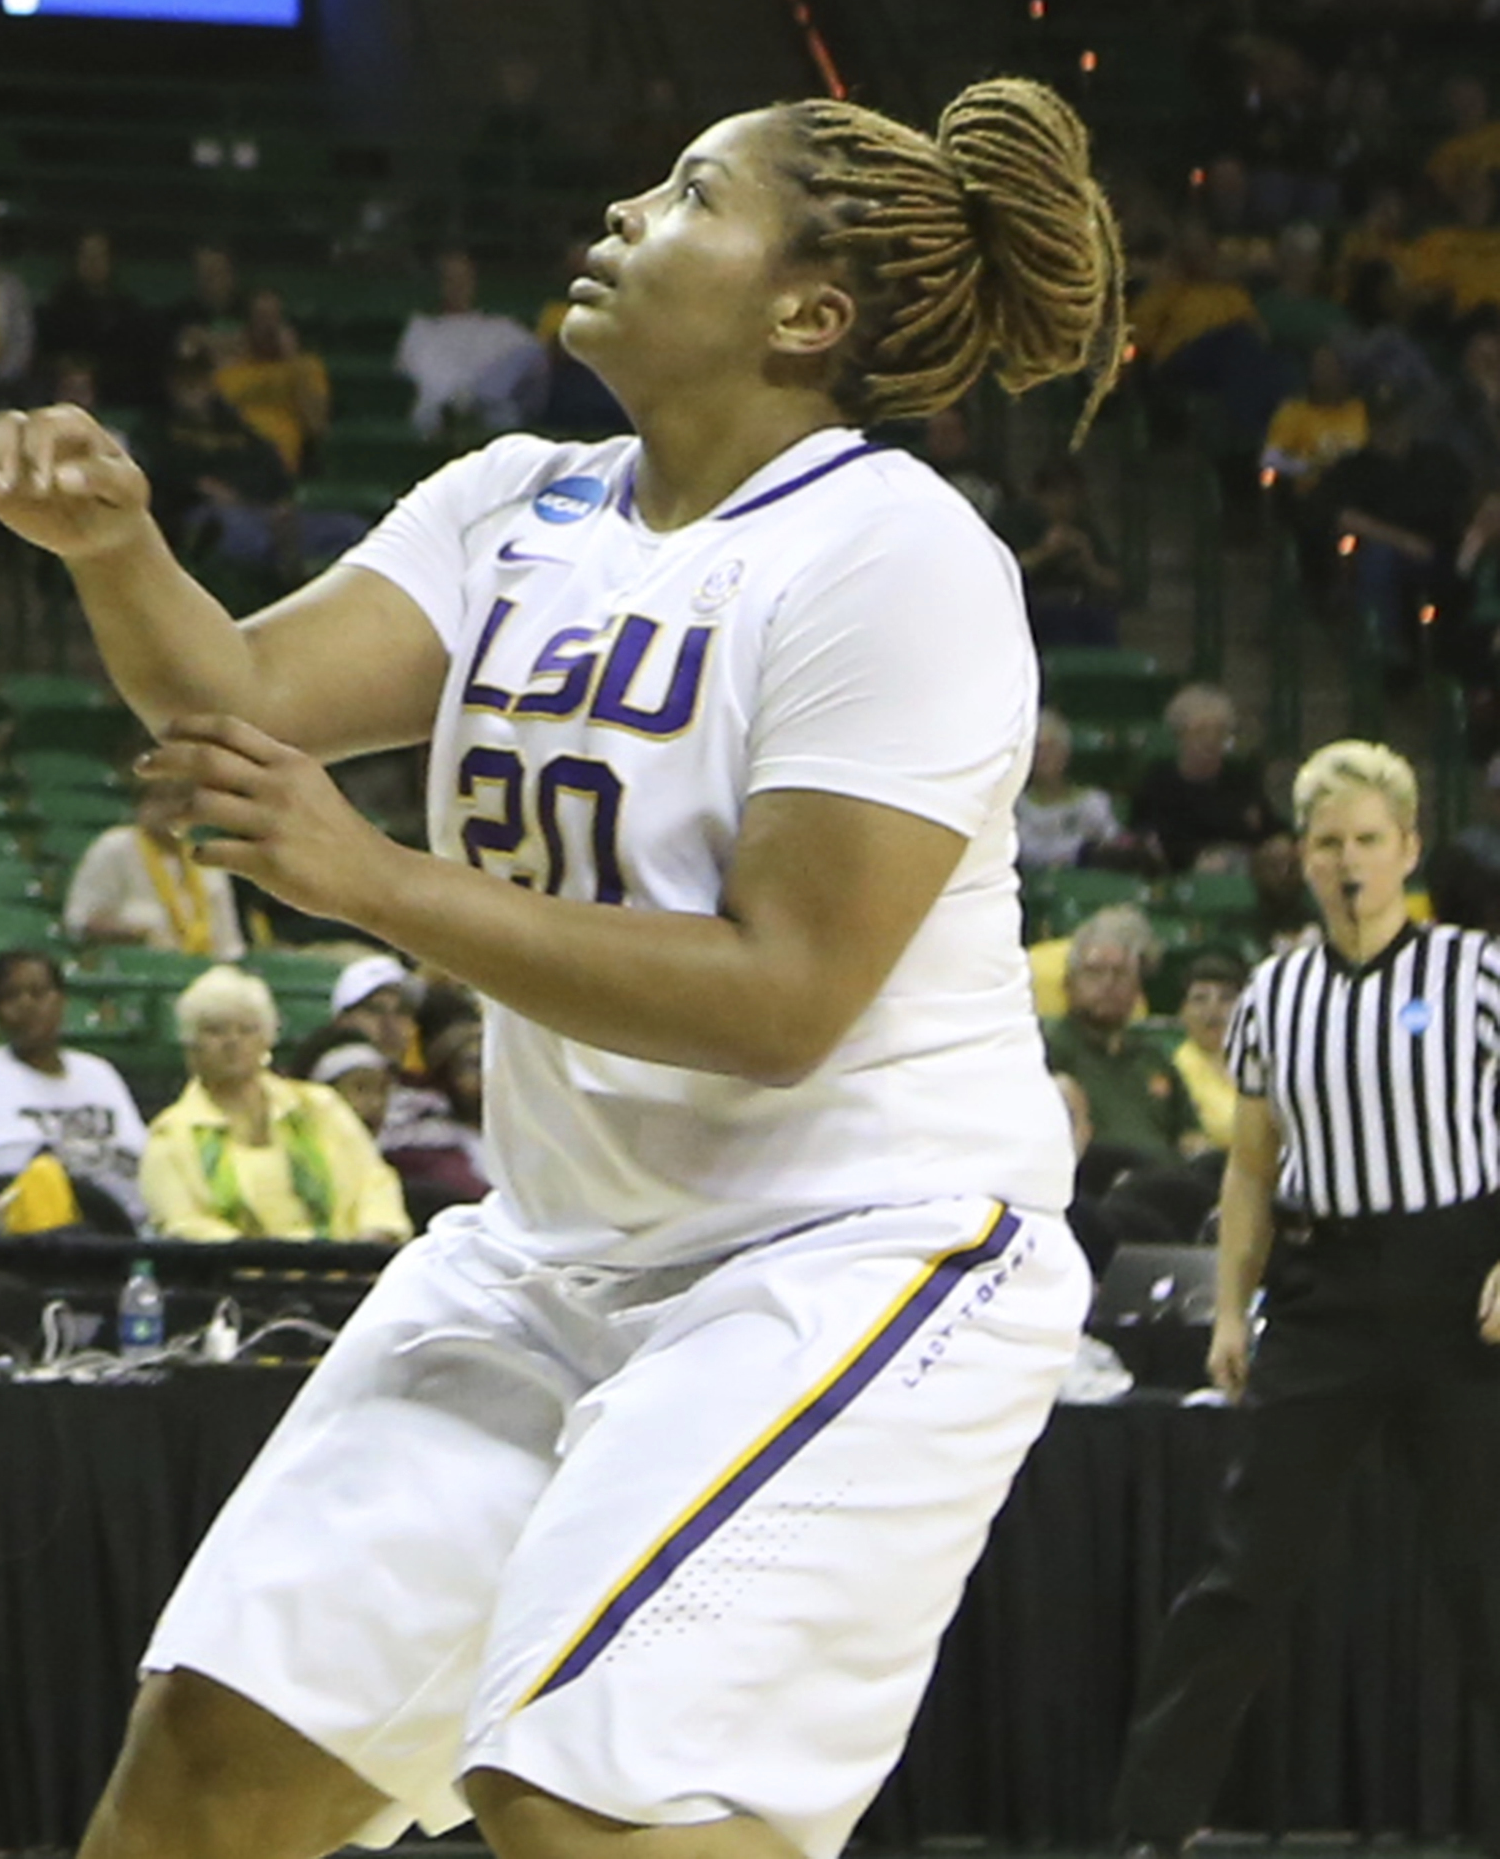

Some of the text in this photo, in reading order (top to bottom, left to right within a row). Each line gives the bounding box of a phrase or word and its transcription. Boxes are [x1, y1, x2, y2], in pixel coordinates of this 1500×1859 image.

[537, 492, 592, 516] NCAA
[462, 596, 719, 744] LSU
[457, 745, 629, 906] 20
